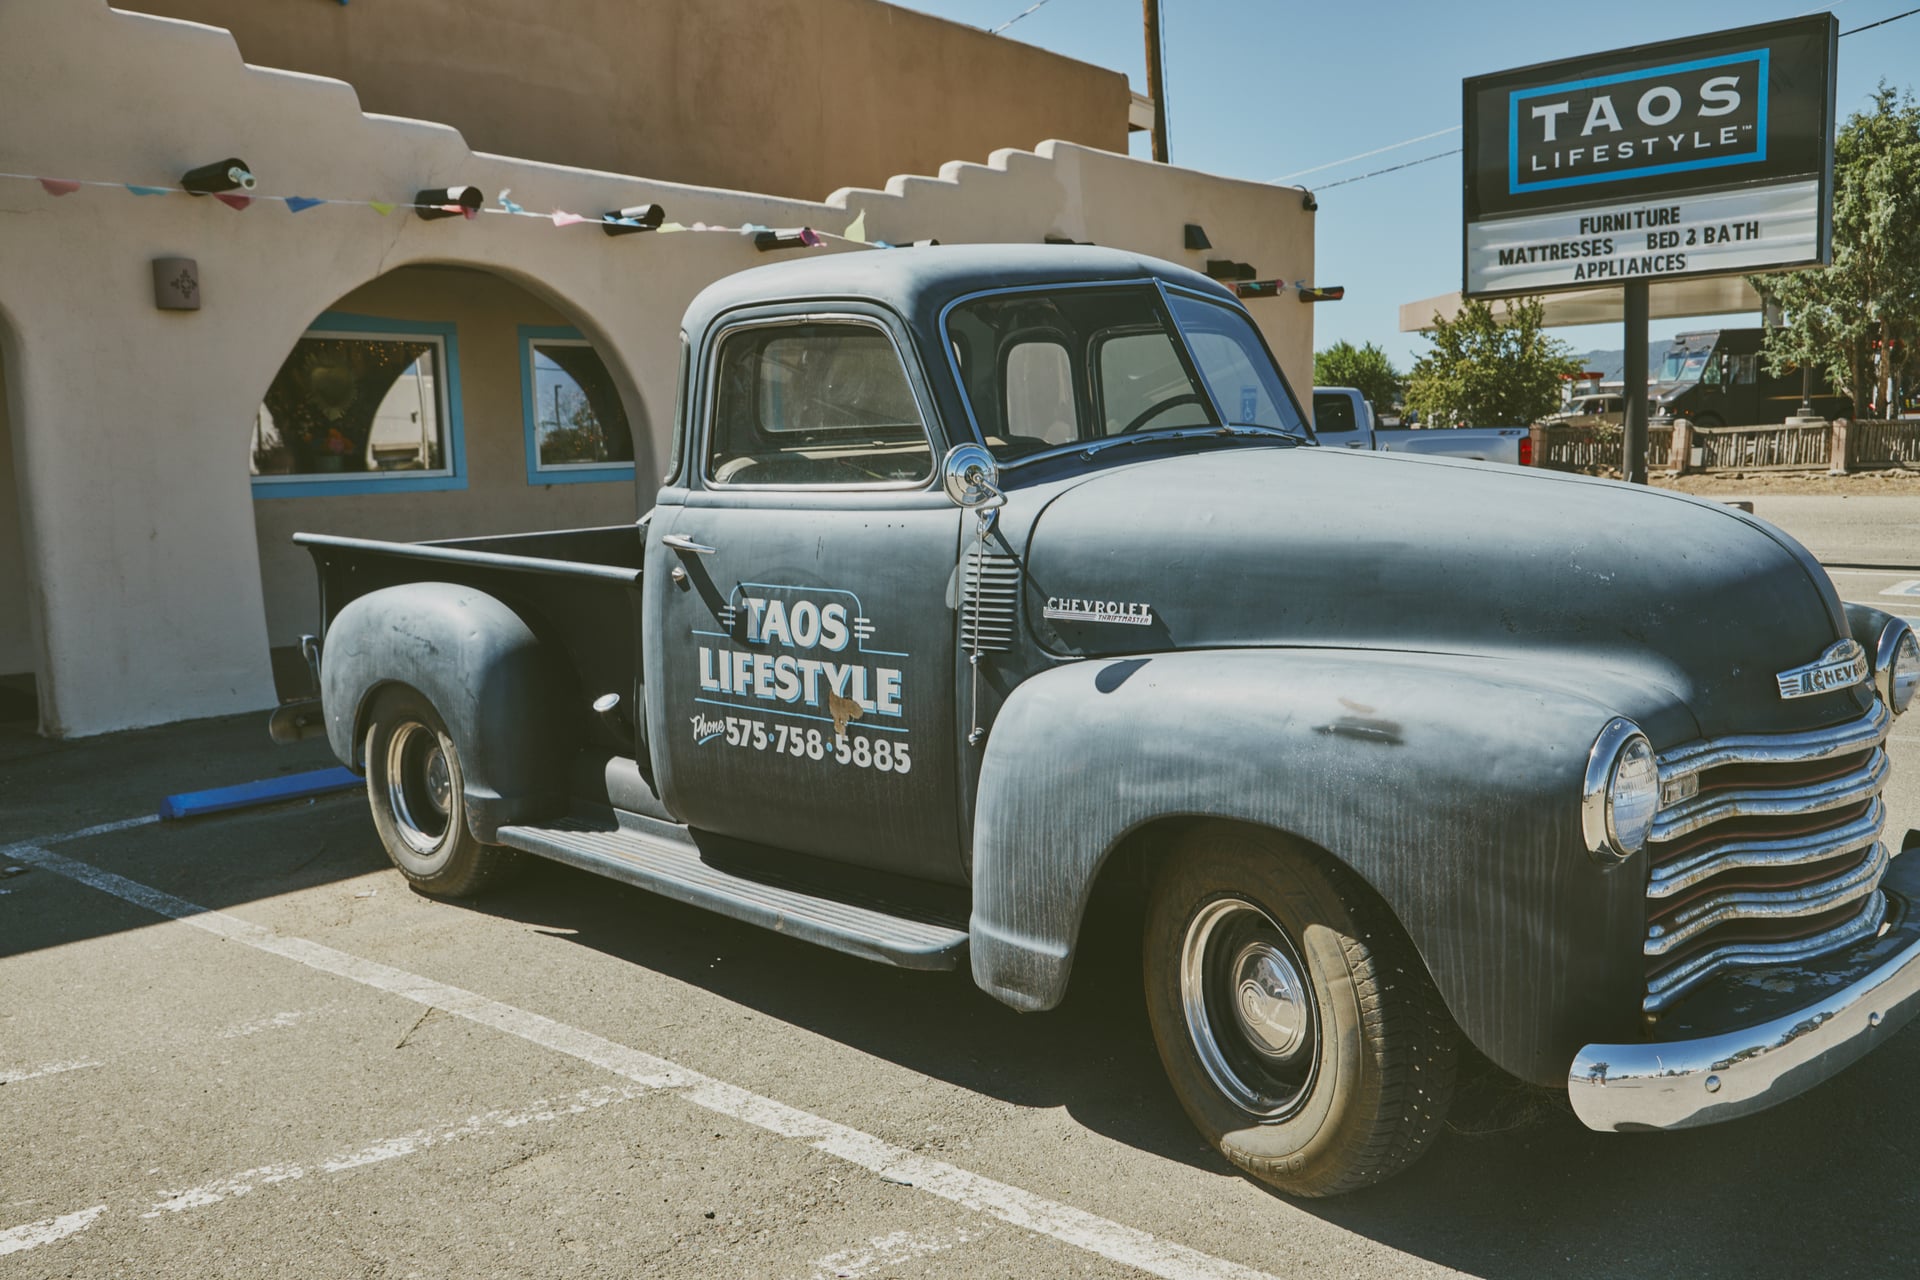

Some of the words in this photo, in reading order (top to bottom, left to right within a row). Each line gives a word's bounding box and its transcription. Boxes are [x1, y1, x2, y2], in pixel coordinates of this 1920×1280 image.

[1531, 76, 1741, 142] TAOS
[1531, 125, 1738, 172] LIFESTYLE
[1499, 239, 1613, 266] MATTRESSES
[1646, 230, 1680, 250] BED
[1703, 220, 1759, 244] BATH
[1579, 206, 1681, 236] FURNITURE
[1574, 253, 1686, 281] APPLIANCES
[742, 597, 850, 652] TAOS
[1047, 596, 1150, 617] CHEVROLET
[699, 646, 903, 718] LIFESTYLE
[690, 713, 726, 741] Phone
